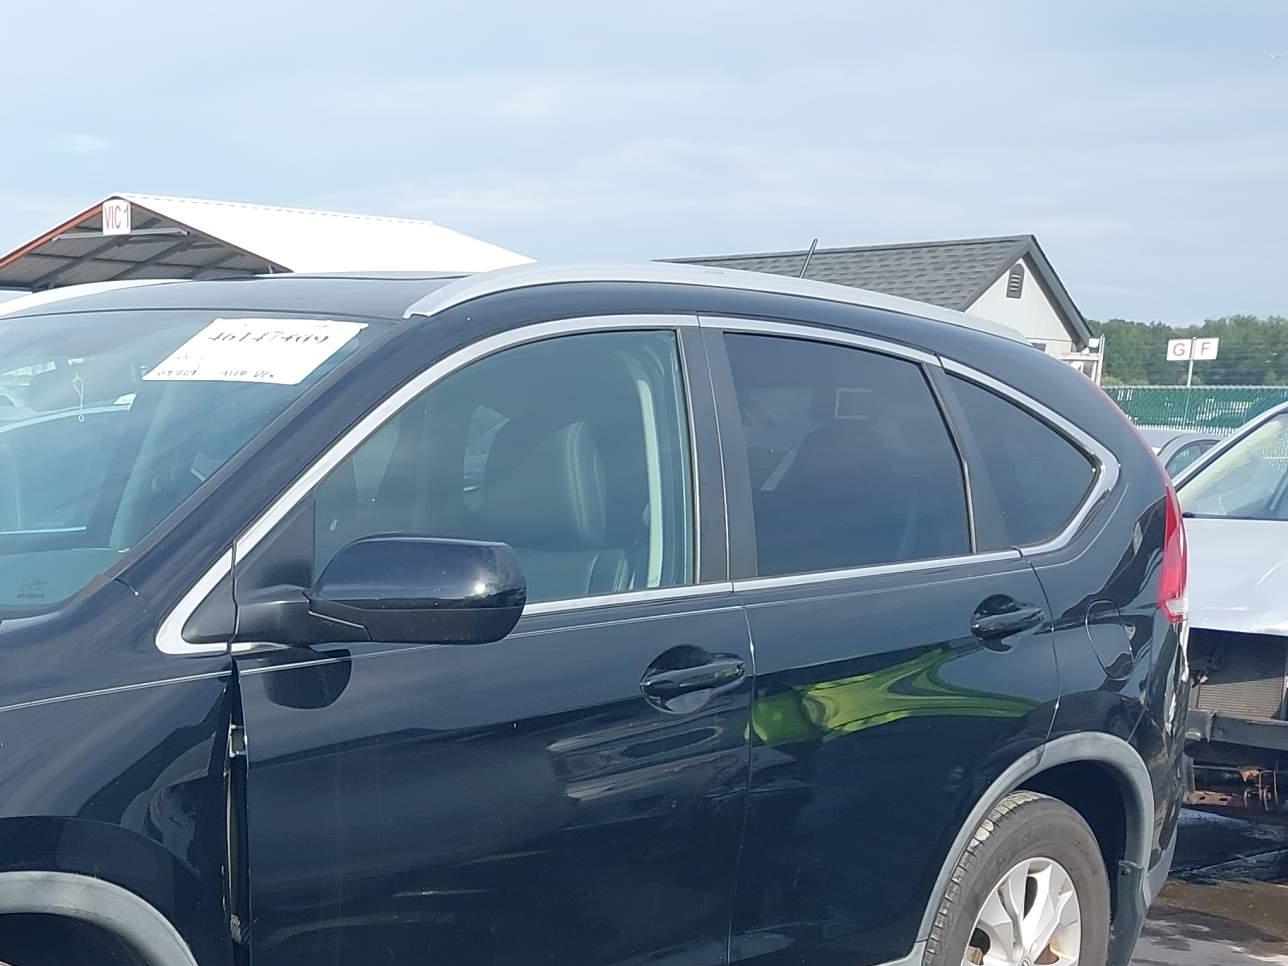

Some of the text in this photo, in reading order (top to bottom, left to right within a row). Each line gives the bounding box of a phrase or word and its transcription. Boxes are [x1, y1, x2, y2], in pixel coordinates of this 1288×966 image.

[105, 205, 122, 230] VIC
[1173, 342, 1186, 357] G
[1200, 342, 1211, 356] F
